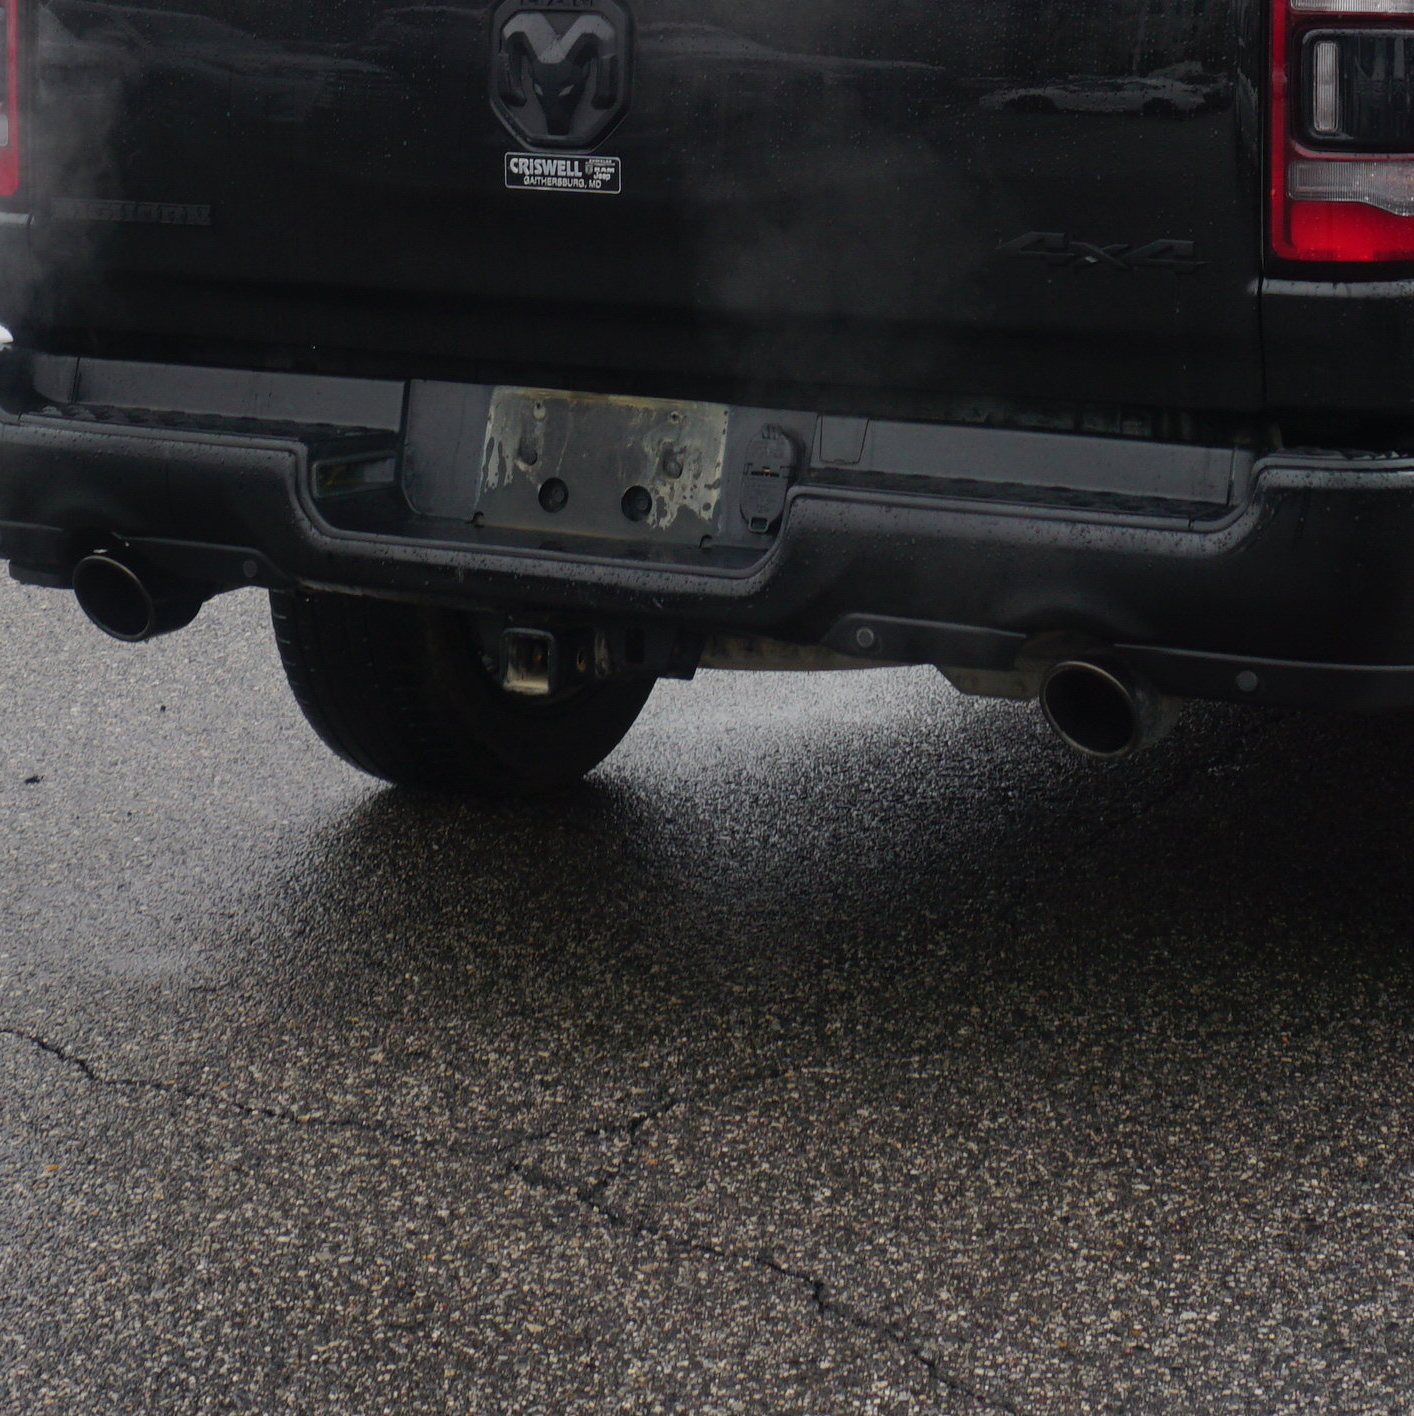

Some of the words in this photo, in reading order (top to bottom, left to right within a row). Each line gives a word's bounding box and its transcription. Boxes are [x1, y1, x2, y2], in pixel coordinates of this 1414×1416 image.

[509, 157, 583, 177] CRISWELL
[523, 176, 587, 189] GAITHERSBURG,
[588, 179, 602, 189] MD
[593, 172, 611, 181] Jeep
